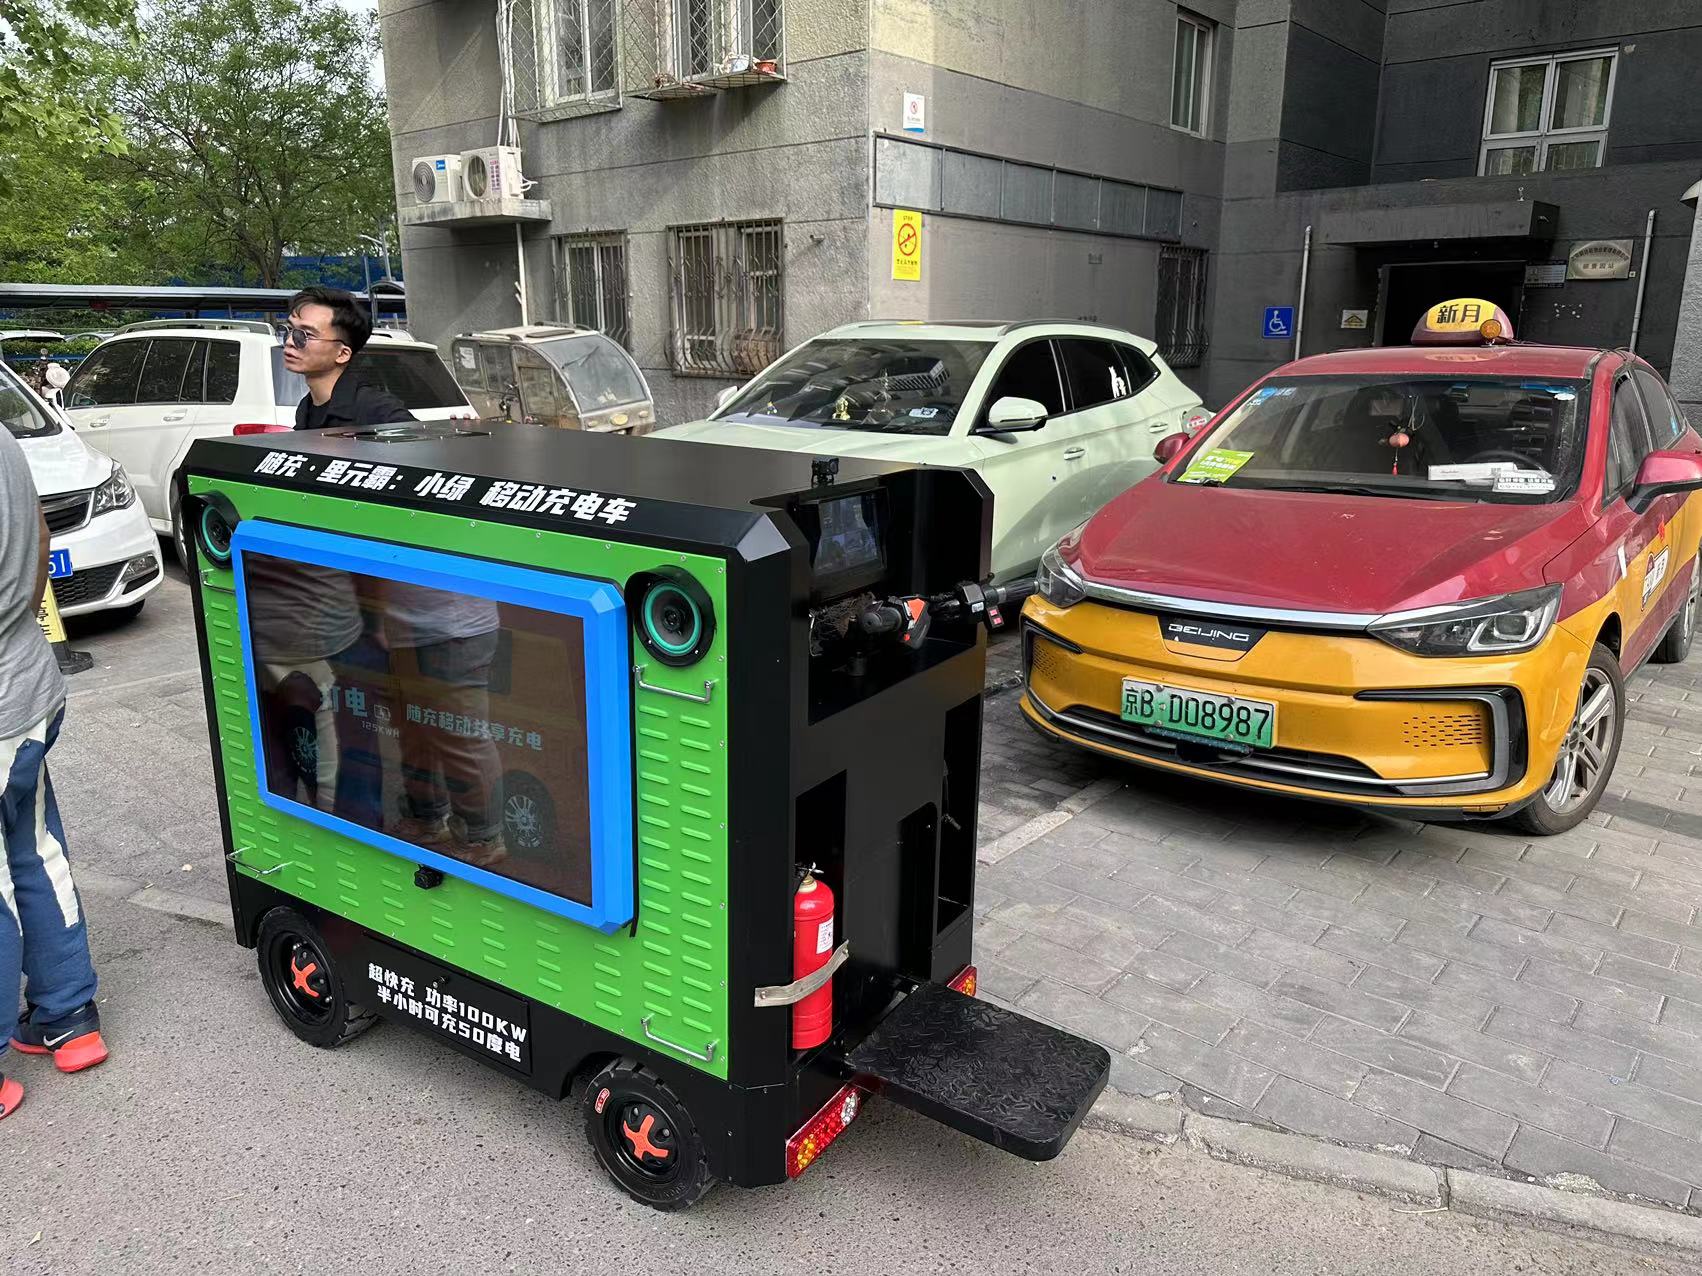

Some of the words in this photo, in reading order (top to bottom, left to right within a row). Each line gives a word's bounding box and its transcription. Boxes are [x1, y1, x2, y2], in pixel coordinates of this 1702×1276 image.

[1436, 303, 1481, 324] 新月
[478, 480, 638, 525] 移动充电车
[1168, 623, 1251, 642] BEIJING
[368, 961, 416, 998] 超快充
[425, 985, 528, 1044] 功率100KW
[376, 983, 522, 1064] 半小时可充50度电
